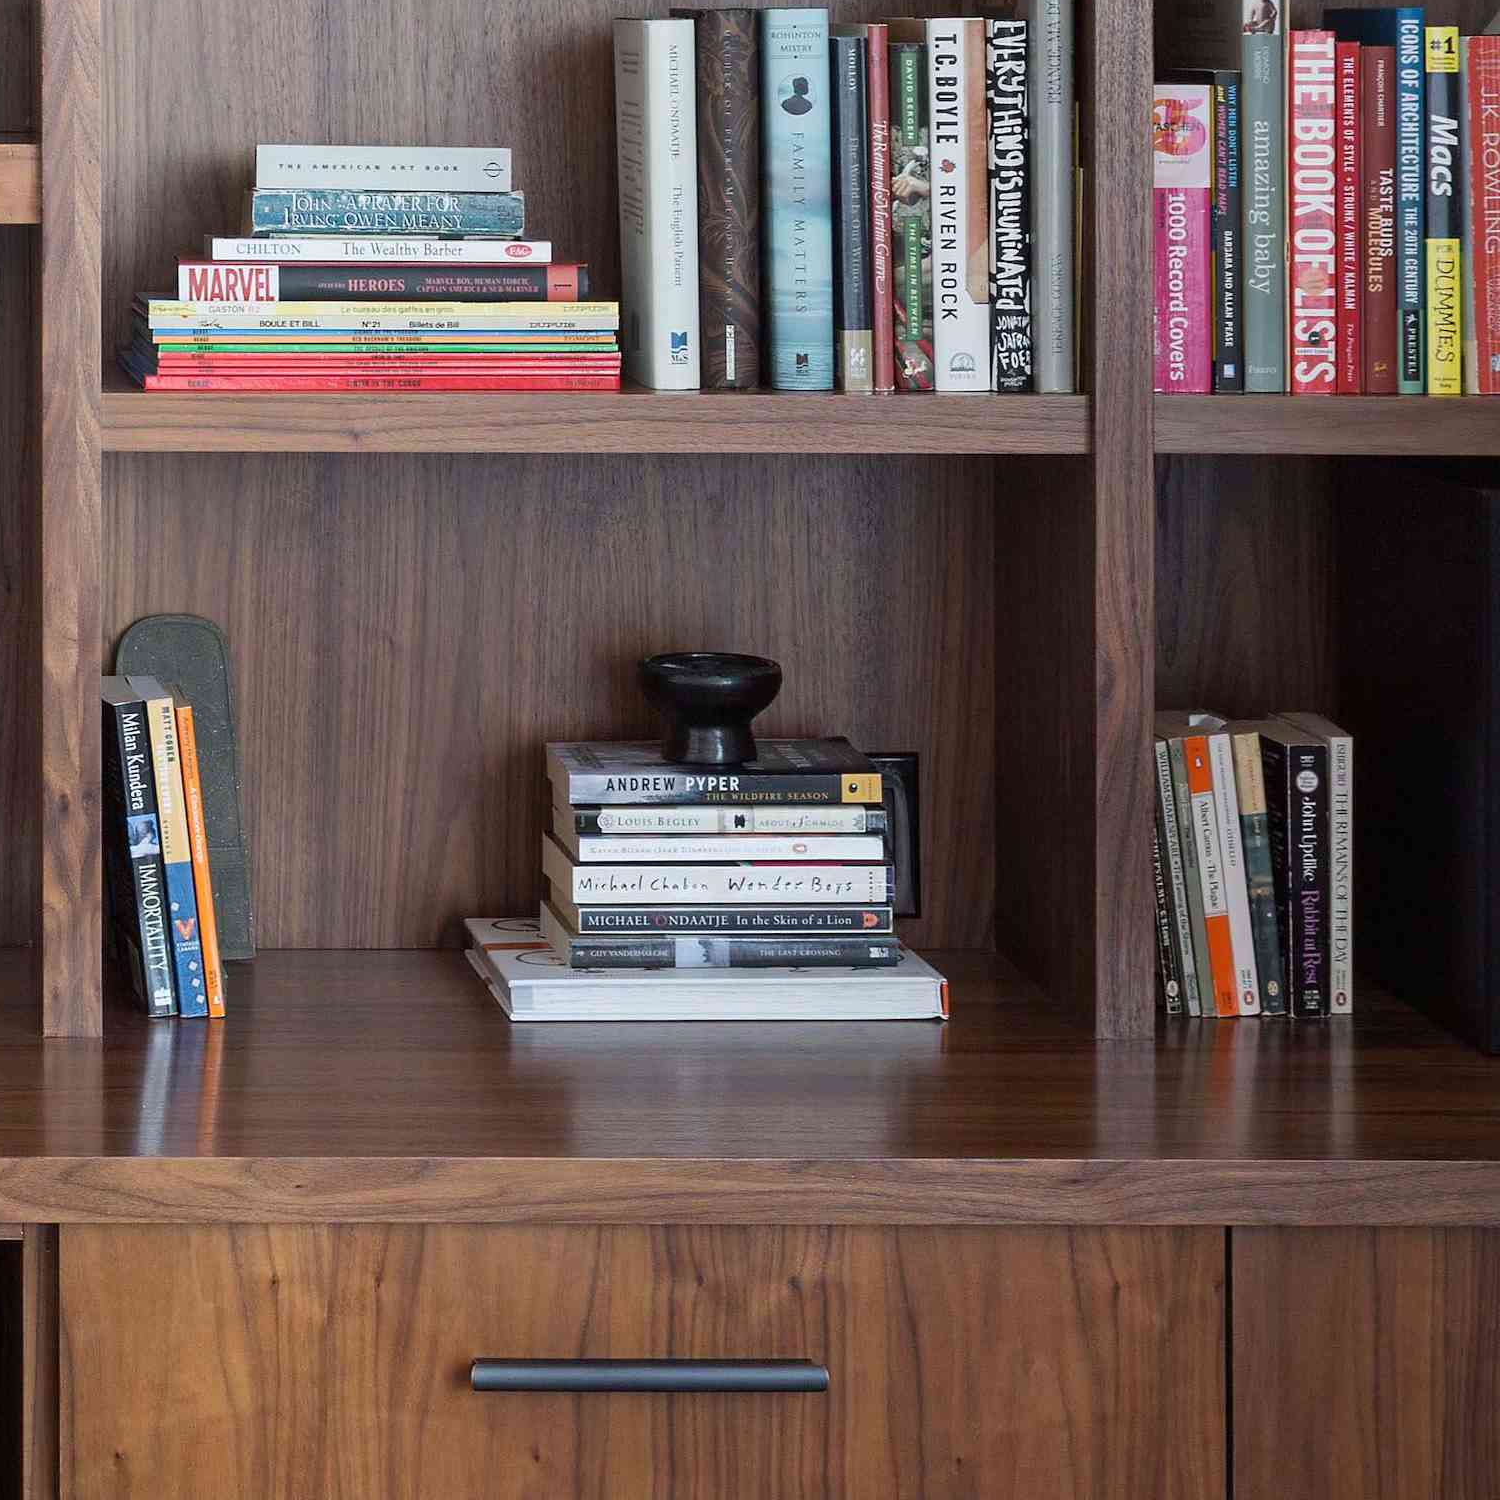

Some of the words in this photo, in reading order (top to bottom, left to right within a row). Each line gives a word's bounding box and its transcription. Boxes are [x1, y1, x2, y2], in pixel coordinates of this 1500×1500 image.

[1401, 19, 1419, 65] ICONS
[1431, 37, 1455, 55] #1
[905, 59, 914, 94] DAVID
[1294, 37, 1335, 105] THE
[1344, 56, 1355, 75] THE
[1401, 69, 1419, 88] OF
[906, 97, 915, 140] BERGEN
[935, 76, 960, 145] BOYLE
[1344, 78, 1355, 126] ELEMENTS
[1344, 130, 1355, 140] OF
[1401, 93, 1420, 201] ARCHITECTURE
[278, 164, 301, 172] THE
[310, 164, 381, 172] AMERICAN
[391, 164, 415, 172] ART
[425, 164, 459, 172] BOOK
[791, 132, 805, 206] FAMILY
[1250, 121, 1274, 226] amazing
[1294, 118, 1335, 219] BOOK
[1344, 143, 1355, 173] STYLE
[1430, 114, 1458, 196] Macs
[672, 185, 683, 206] The
[1344, 185, 1355, 223] STRUNK
[1379, 168, 1393, 212] TASTE
[1482, 132, 1498, 254] ROWLING
[670, 210, 684, 248] English
[908, 223, 917, 245] THE
[940, 185, 957, 250] RIVEN
[1167, 193, 1186, 241] 1000
[1405, 207, 1417, 227] THE
[236, 243, 302, 255] CHILTON
[341, 242, 367, 257] The
[370, 241, 421, 259] Wealthy
[423, 243, 463, 257] Barber
[1294, 229, 1335, 275] OF
[1344, 232, 1355, 262] WHITE
[1368, 207, 1382, 292] MOLECULES
[1380, 218, 1393, 257] BUDS
[1405, 229, 1418, 256] 20TH
[672, 251, 685, 287] Patient
[793, 219, 808, 314] MATTERS
[909, 248, 918, 272] TIME
[1167, 245, 1187, 312] Record
[1250, 233, 1275, 294] baby
[187, 267, 275, 301] MARVEL
[347, 278, 405, 292] HEROES
[910, 275, 918, 286] IN
[940, 262, 958, 321] ROCK
[1344, 272, 1356, 309] KALMAN
[1405, 259, 1418, 303] CENTURY
[259, 320, 290, 328] BOULE
[292, 320, 301, 328] ET
[303, 320, 320, 328] BILL
[409, 320, 435, 329] Billets
[437, 320, 446, 329] de
[448, 321, 460, 329] Bill
[910, 288, 919, 336] BETWEEN
[1436, 259, 1455, 362] DUMMIES
[1169, 316, 1188, 381] Covers
[1294, 288, 1335, 383] LISTS
[1408, 327, 1417, 374] PRESTEL
[121, 713, 138, 752] Milan
[125, 754, 146, 810] Kundera
[605, 776, 676, 793] ANDREW
[685, 776, 740, 792] PYPER
[705, 792, 727, 801] THE
[731, 792, 784, 801] WILDFIRE
[787, 791, 829, 800] SEASON
[1302, 796, 1317, 833] John
[1299, 835, 1318, 882] Updike
[578, 877, 644, 891] Michael
[650, 877, 709, 893] Chabon
[728, 877, 803, 892] Wonder
[811, 877, 853, 894] Boys
[138, 863, 167, 971] IMMORTALITY
[588, 914, 651, 926] MICHAEL
[655, 913, 729, 926] ONDAATJE
[736, 915, 747, 926] In
[750, 915, 769, 926] the
[773, 914, 798, 926] Skin
[801, 914, 813, 926] of
[815, 917, 821, 926] a
[826, 915, 853, 926] Lion
